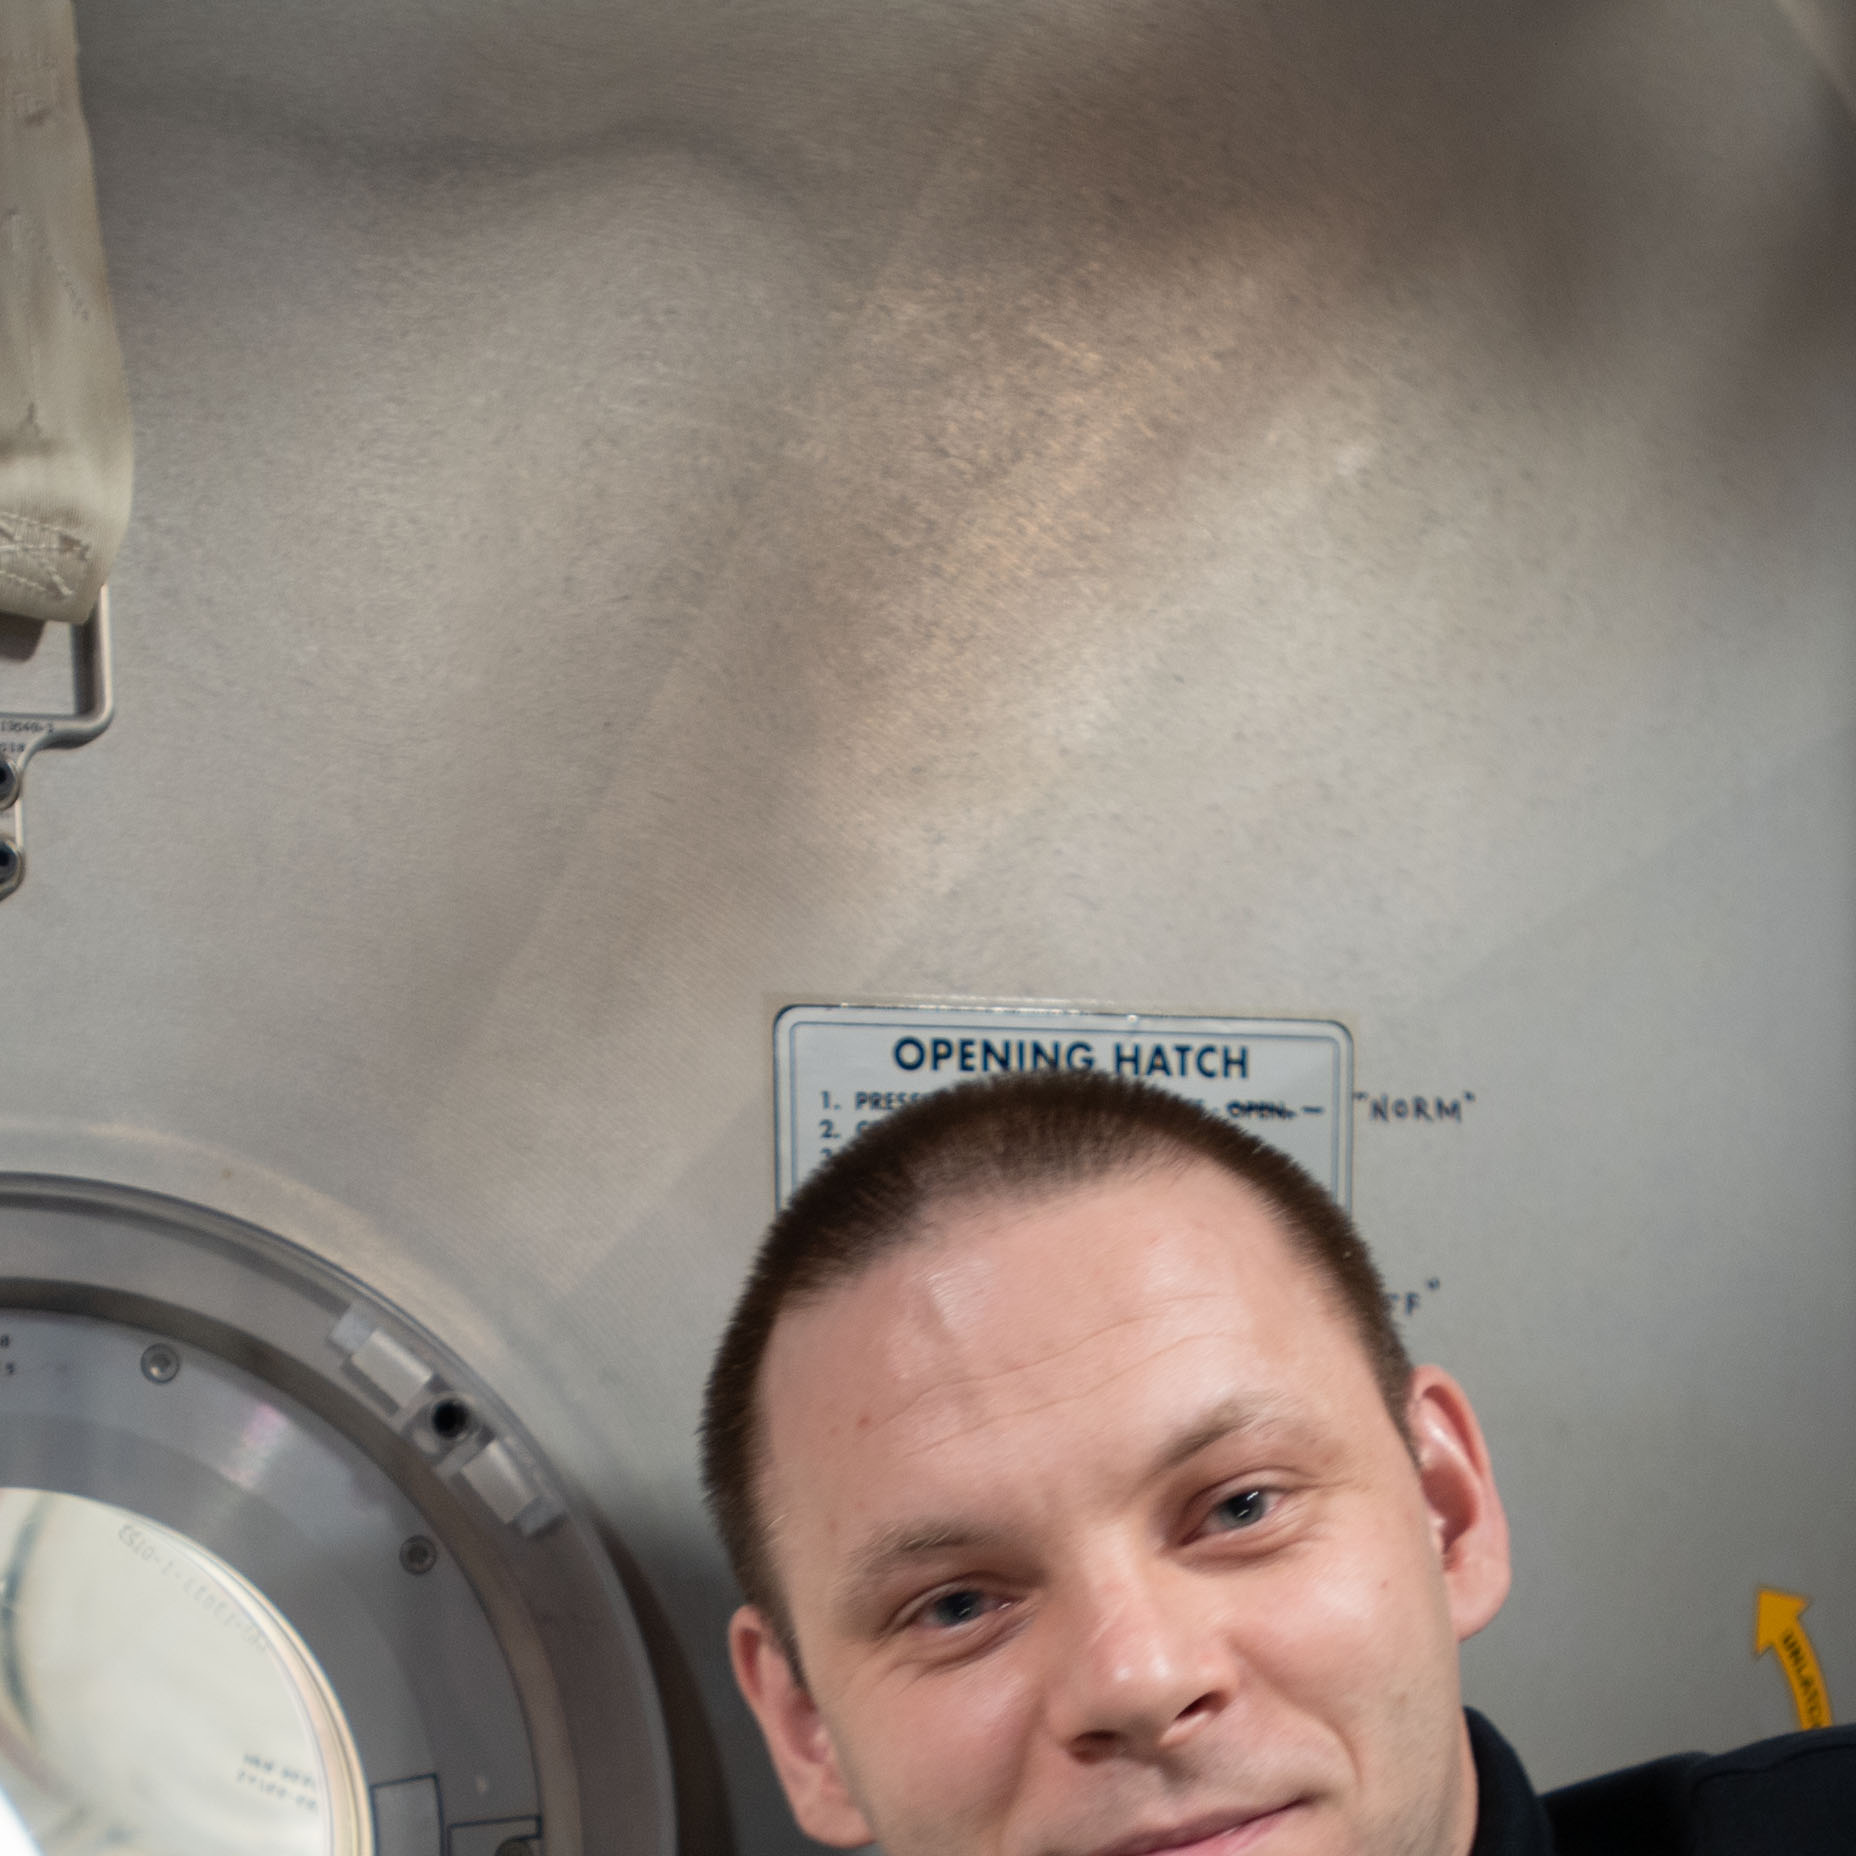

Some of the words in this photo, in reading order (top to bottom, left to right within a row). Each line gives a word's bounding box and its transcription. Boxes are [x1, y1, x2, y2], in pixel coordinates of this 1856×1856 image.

[893, 1036, 1096, 1074] OPENING
[1114, 1040, 1250, 1080] HATCH
[820, 1090, 842, 1111] 1.
[819, 1119, 841, 1139] 2.
